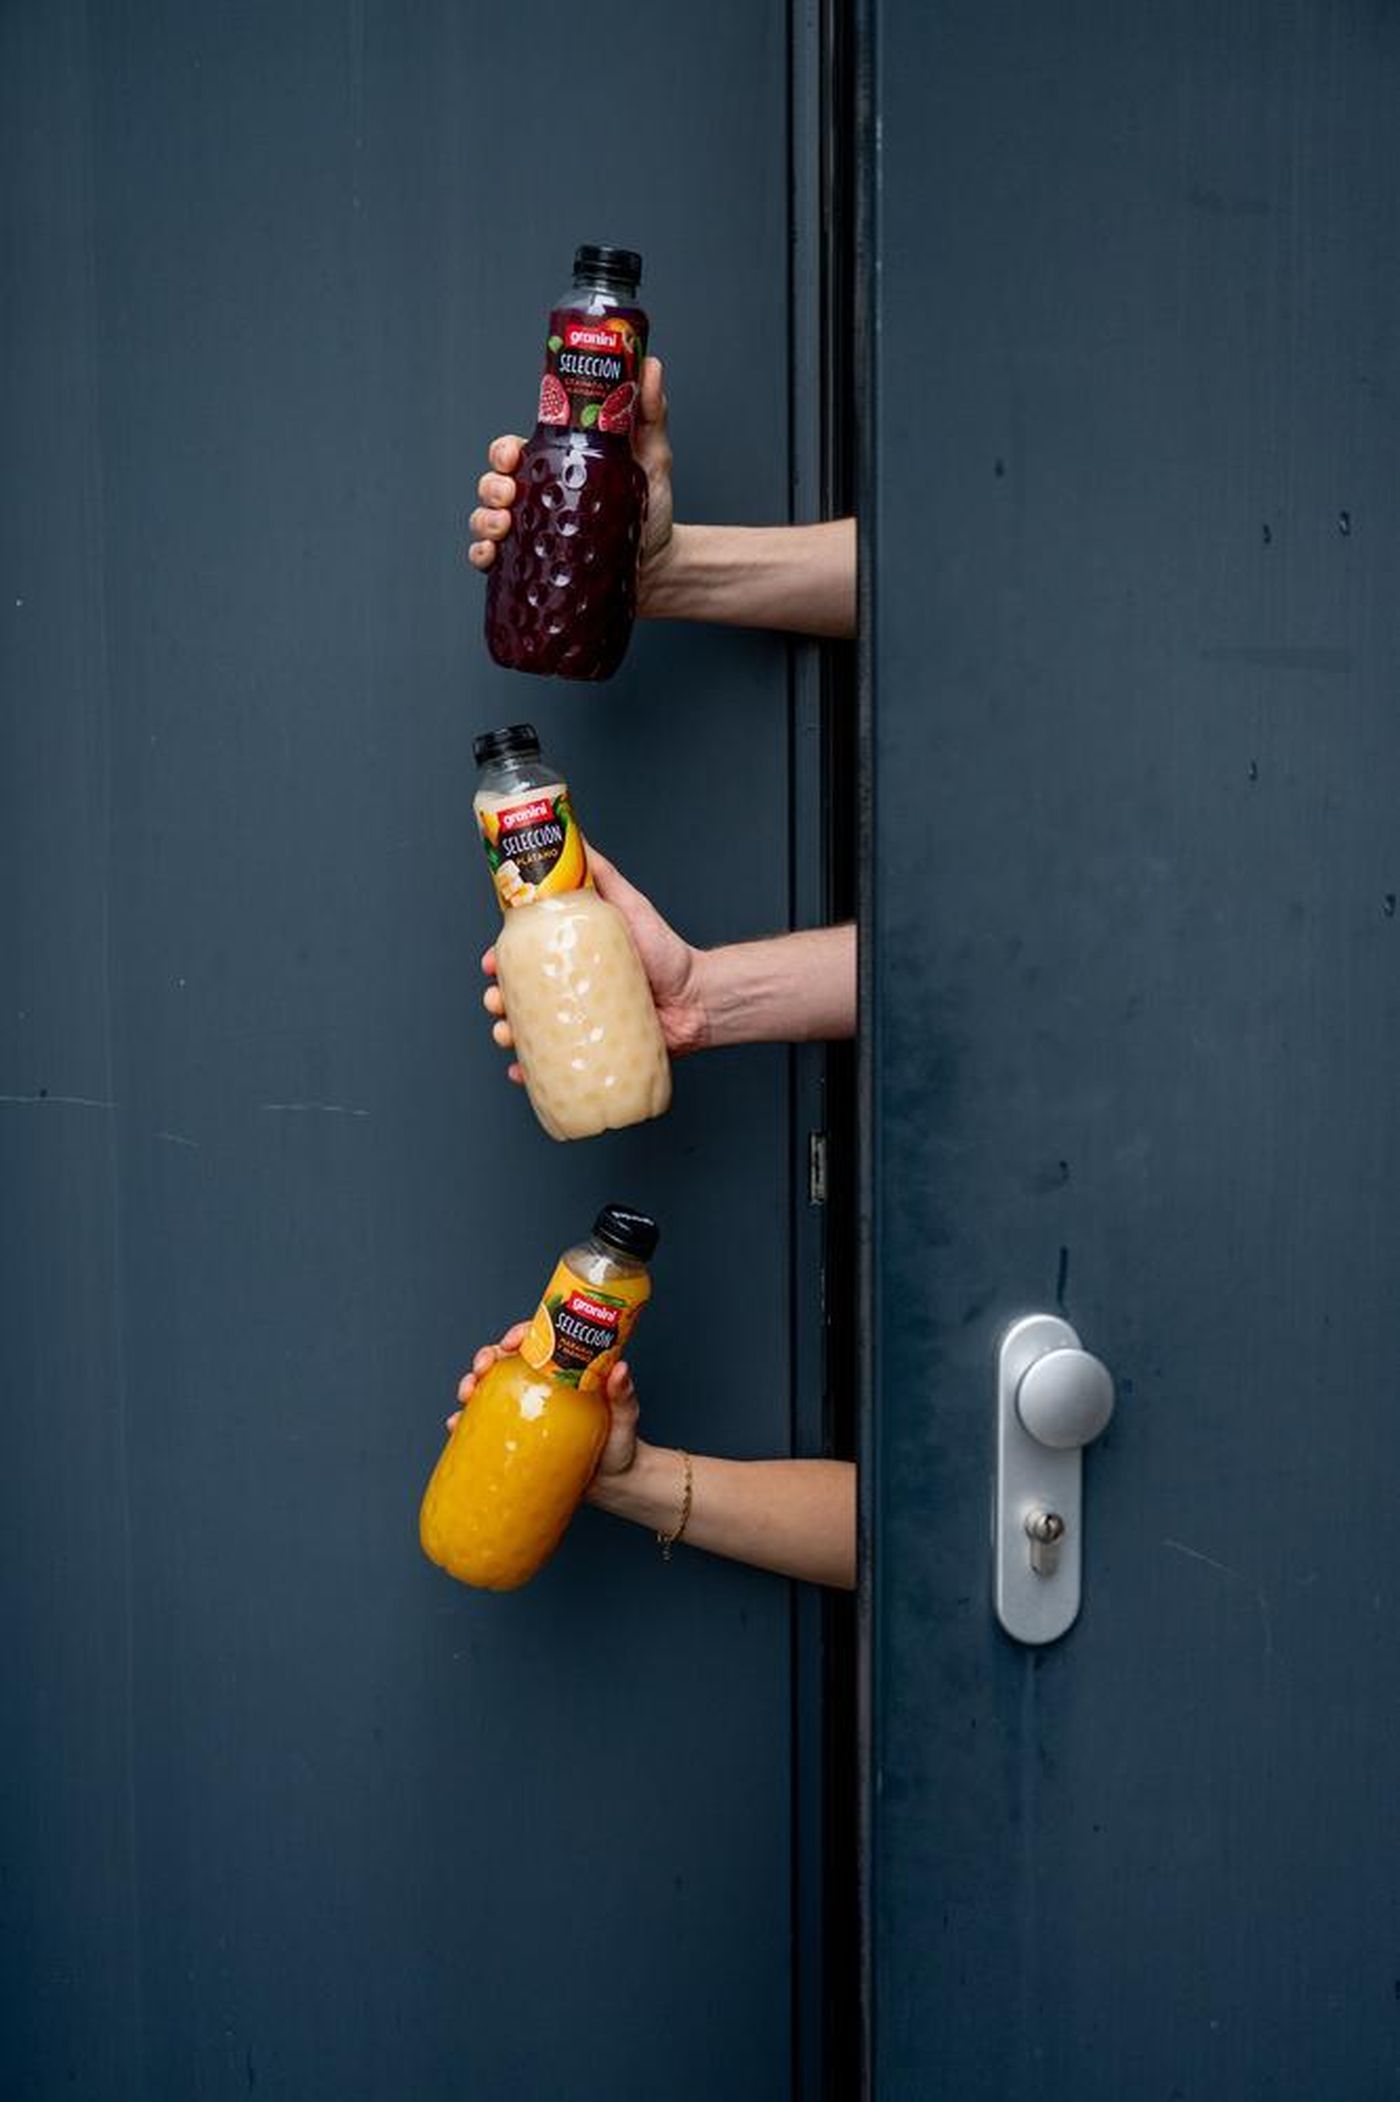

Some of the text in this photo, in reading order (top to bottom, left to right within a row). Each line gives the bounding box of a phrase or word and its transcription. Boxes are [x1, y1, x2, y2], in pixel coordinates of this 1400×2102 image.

[570, 331, 618, 348] granini
[503, 801, 548, 829] granini
[571, 1298, 618, 1323] granini
